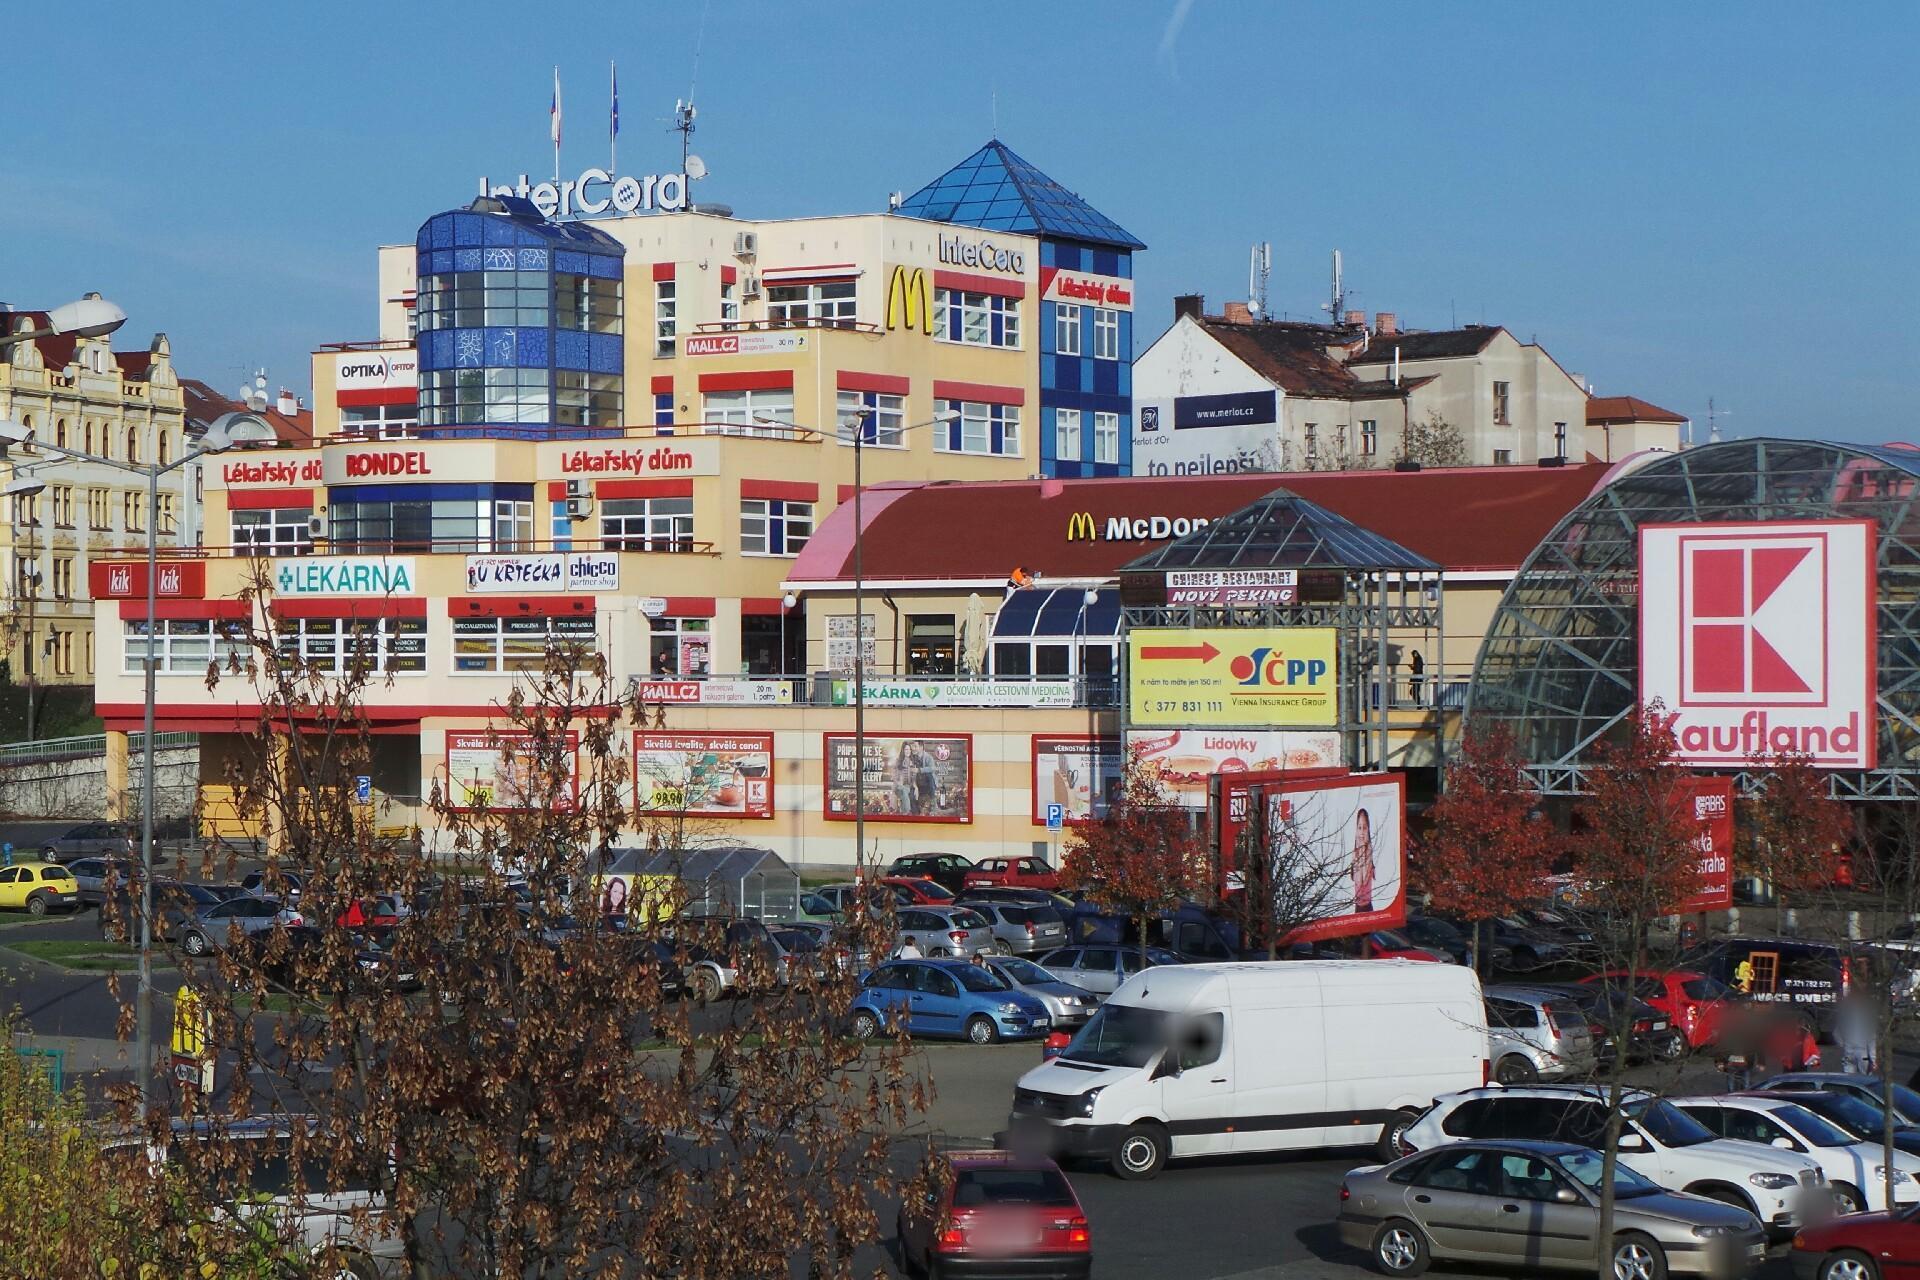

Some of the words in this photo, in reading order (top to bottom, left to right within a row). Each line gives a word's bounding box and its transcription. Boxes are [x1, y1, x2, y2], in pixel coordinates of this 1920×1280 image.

[479, 168, 687, 218] InterCora
[938, 232, 1025, 275] InterCora
[1058, 276, 1104, 305] Lékařský
[1105, 283, 1131, 306] dům
[688, 338, 737, 353] MALL.CZ
[341, 364, 385, 378] OPTIKA
[1196, 407, 1254, 419] www.merlot.cz
[346, 451, 431, 477] RONDEL
[562, 449, 644, 475] Lékařský
[648, 447, 693, 470] dům
[1148, 459, 1168, 476] to
[223, 461, 298, 486] Lékařský
[301, 459, 323, 481] dů
[494, 558, 561, 582] KRTEČKA
[570, 555, 616, 578] chicco
[296, 561, 410, 592] LÉKÁRNA
[570, 579, 597, 587] partner
[599, 577, 616, 586] shop
[1222, 571, 1292, 585] RESTAURANT
[1172, 587, 1220, 602] NOVÝ
[1227, 589, 1292, 601] PEKING
[1265, 652, 1326, 686] ČPP
[642, 685, 698, 699] MALL.CZ
[851, 684, 921, 699] LÉKÁRNA
[1156, 701, 1177, 712] 377
[1182, 701, 1201, 712] 831
[1207, 701, 1222, 712] 111
[1649, 710, 1859, 753] Kaufland
[1204, 737, 1258, 753] Lidovky
[862, 771, 882, 782] EČERY
